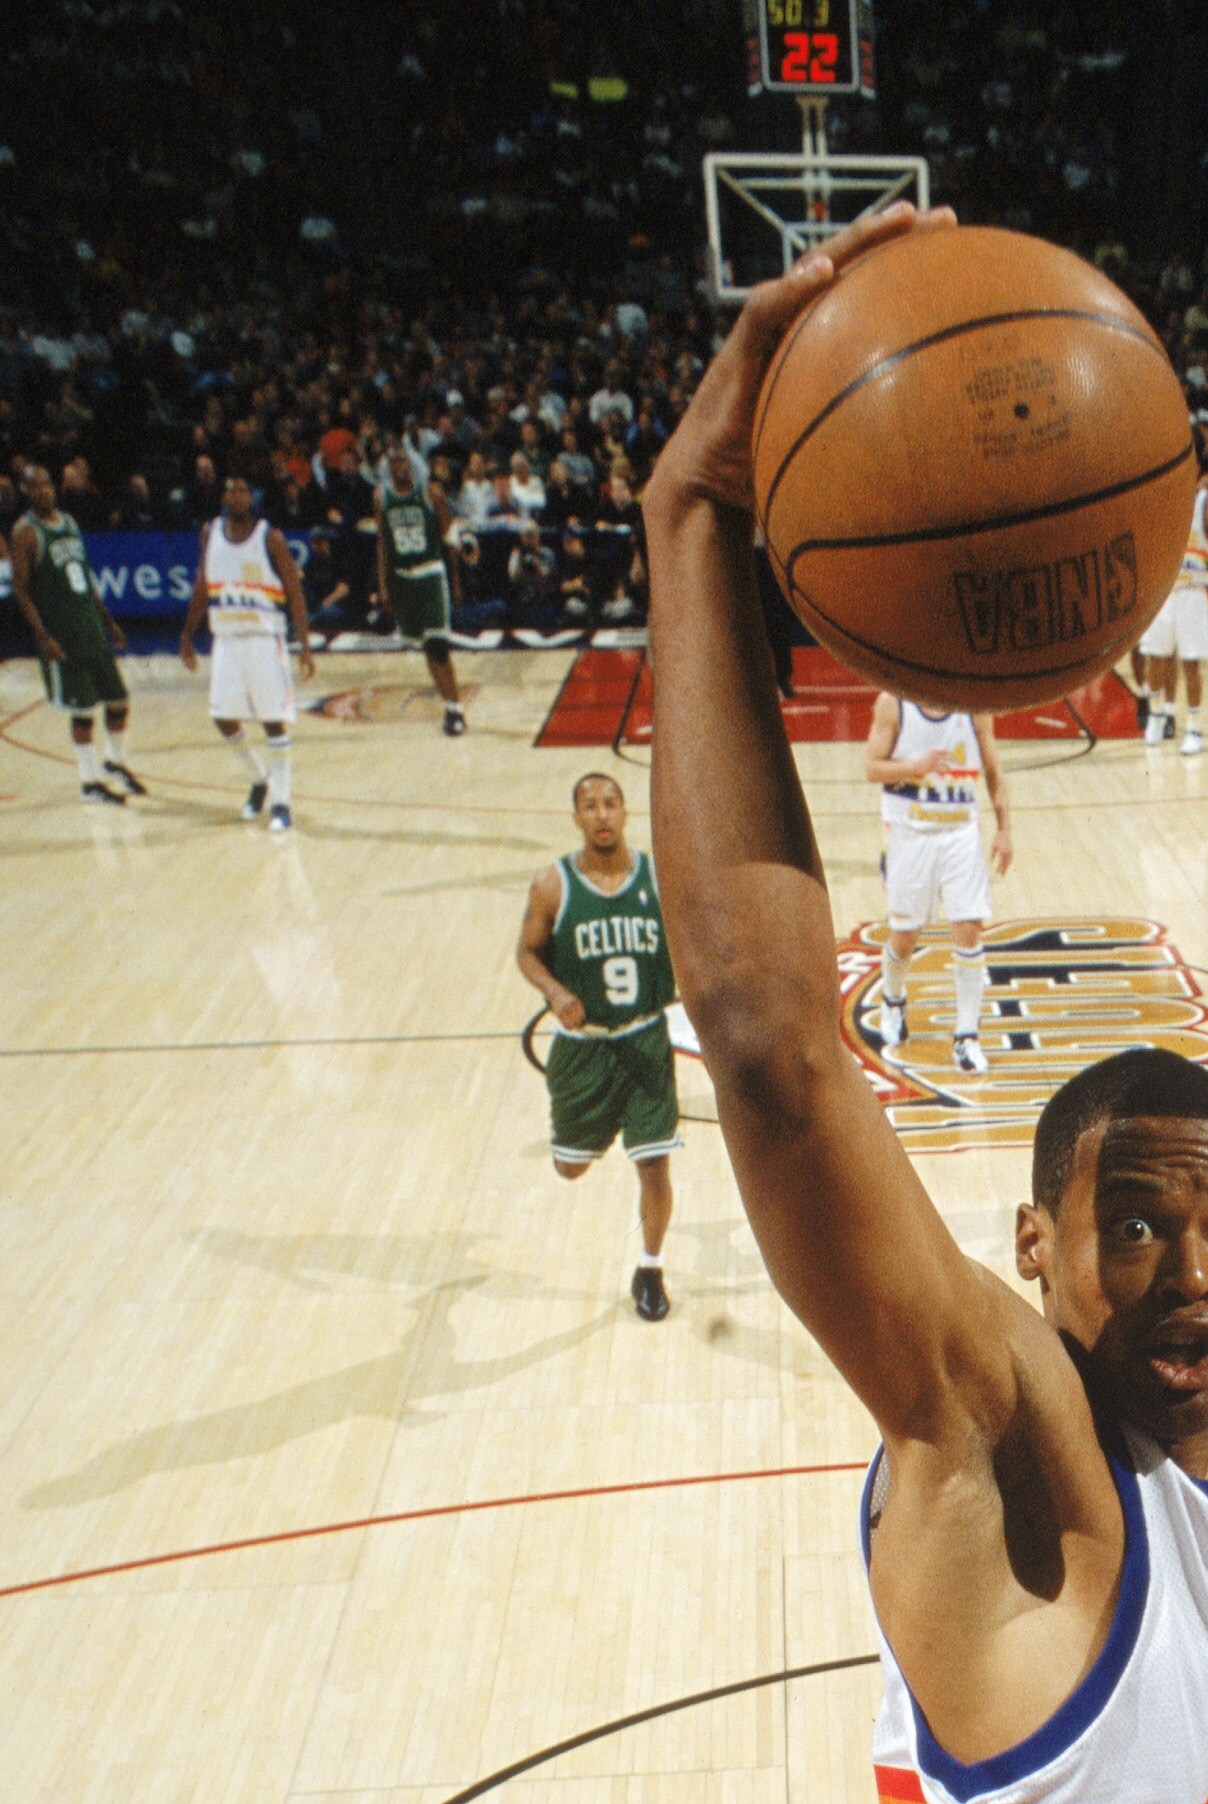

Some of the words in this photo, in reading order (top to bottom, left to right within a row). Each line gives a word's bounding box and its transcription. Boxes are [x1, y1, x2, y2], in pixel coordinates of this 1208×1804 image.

[781, 32, 838, 83] 22
[953, 549, 1100, 655] NBA
[575, 915, 659, 959] CELTICS
[602, 956, 639, 1006] 9
